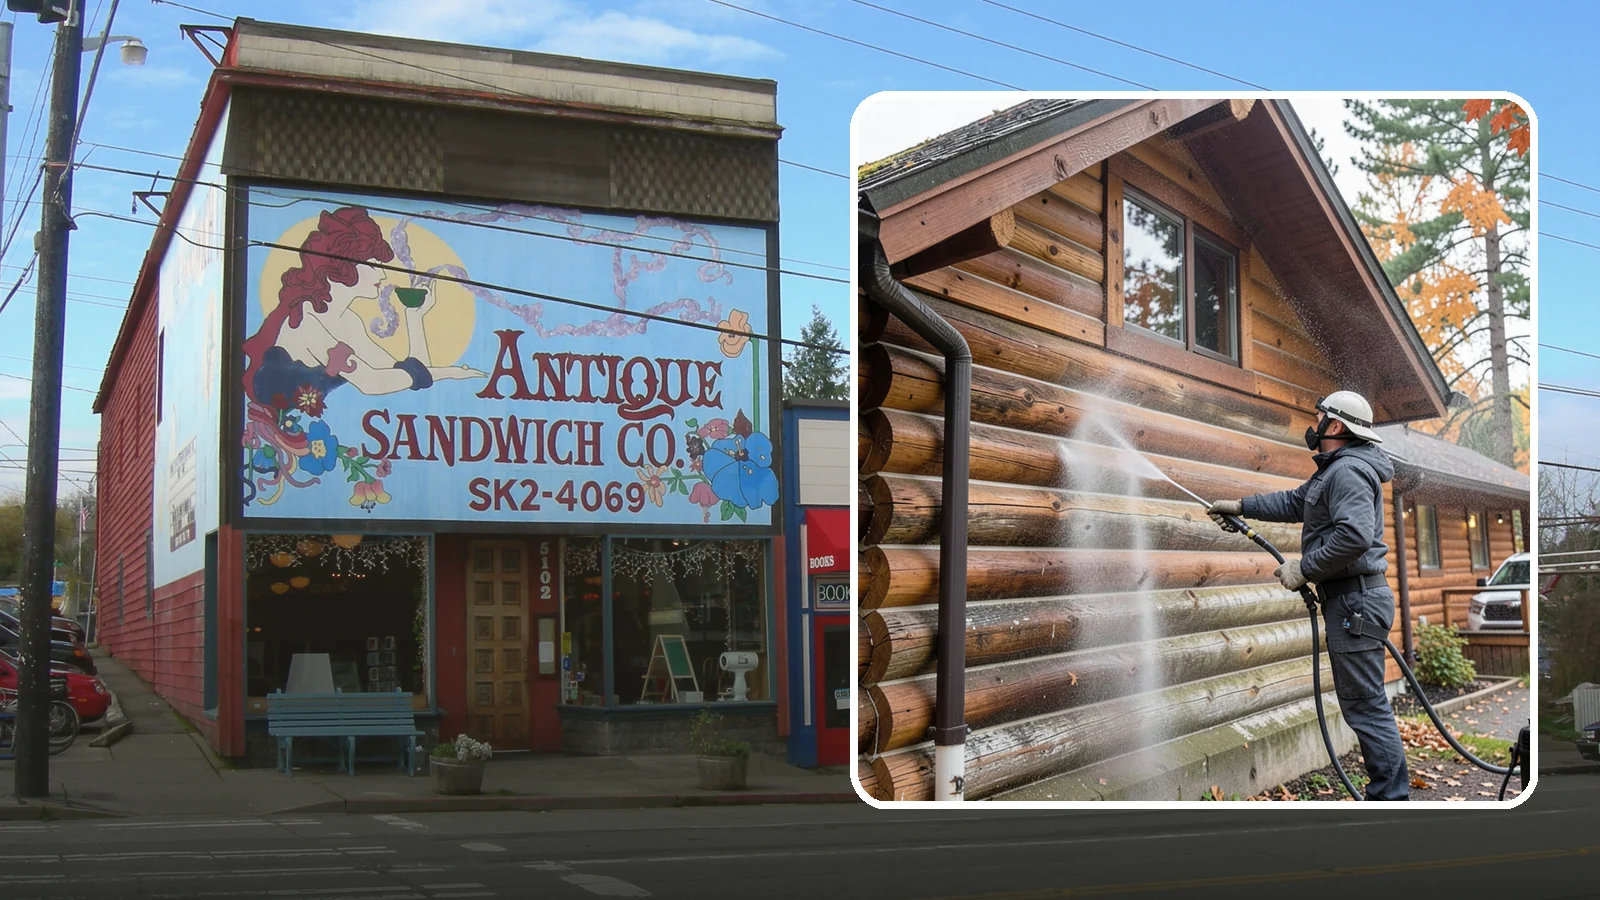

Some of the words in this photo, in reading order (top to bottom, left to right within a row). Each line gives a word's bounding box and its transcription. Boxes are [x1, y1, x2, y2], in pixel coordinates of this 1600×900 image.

[476, 329, 723, 420] ANTIQUE
[362, 409, 604, 467] SANDWICH
[617, 423, 685, 468] CO.
[470, 478, 645, 512] SK2-4069
[539, 542, 552, 599] 5102
[809, 555, 835, 569] BOOKS
